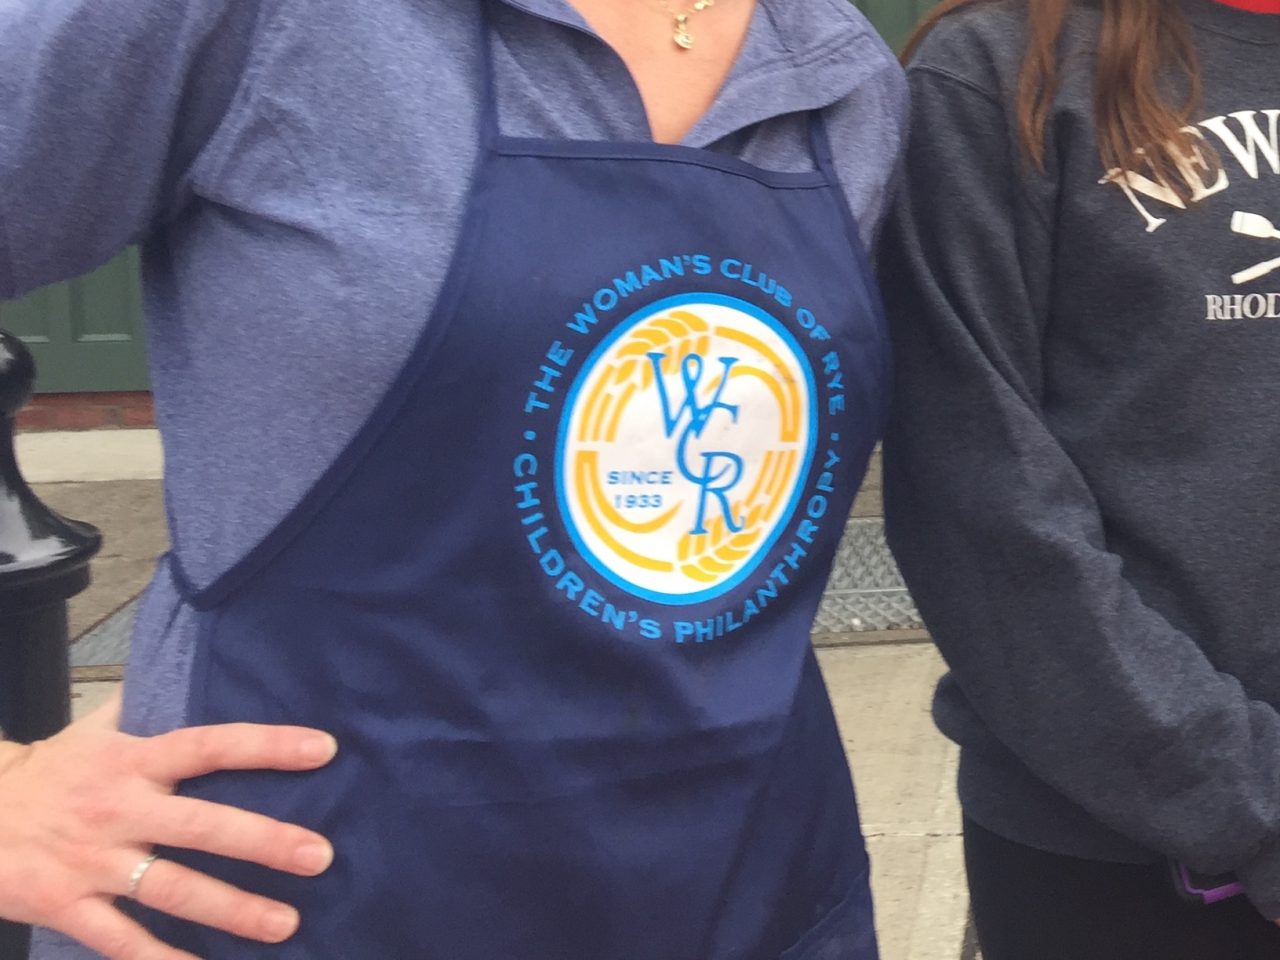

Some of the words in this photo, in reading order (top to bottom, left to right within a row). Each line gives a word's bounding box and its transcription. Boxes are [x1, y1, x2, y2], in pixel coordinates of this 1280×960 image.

[524, 341, 575, 414] THE
[566, 254, 712, 335] WOMAN'S
[720, 258, 793, 308] CLUB
[796, 308, 831, 342] OF
[821, 351, 847, 416] RYE
[607, 470, 674, 487] SINCE
[613, 493, 664, 510] 1933
[512, 452, 662, 640] CHILDREN'S
[673, 452, 841, 643] PHILANTHROPY
